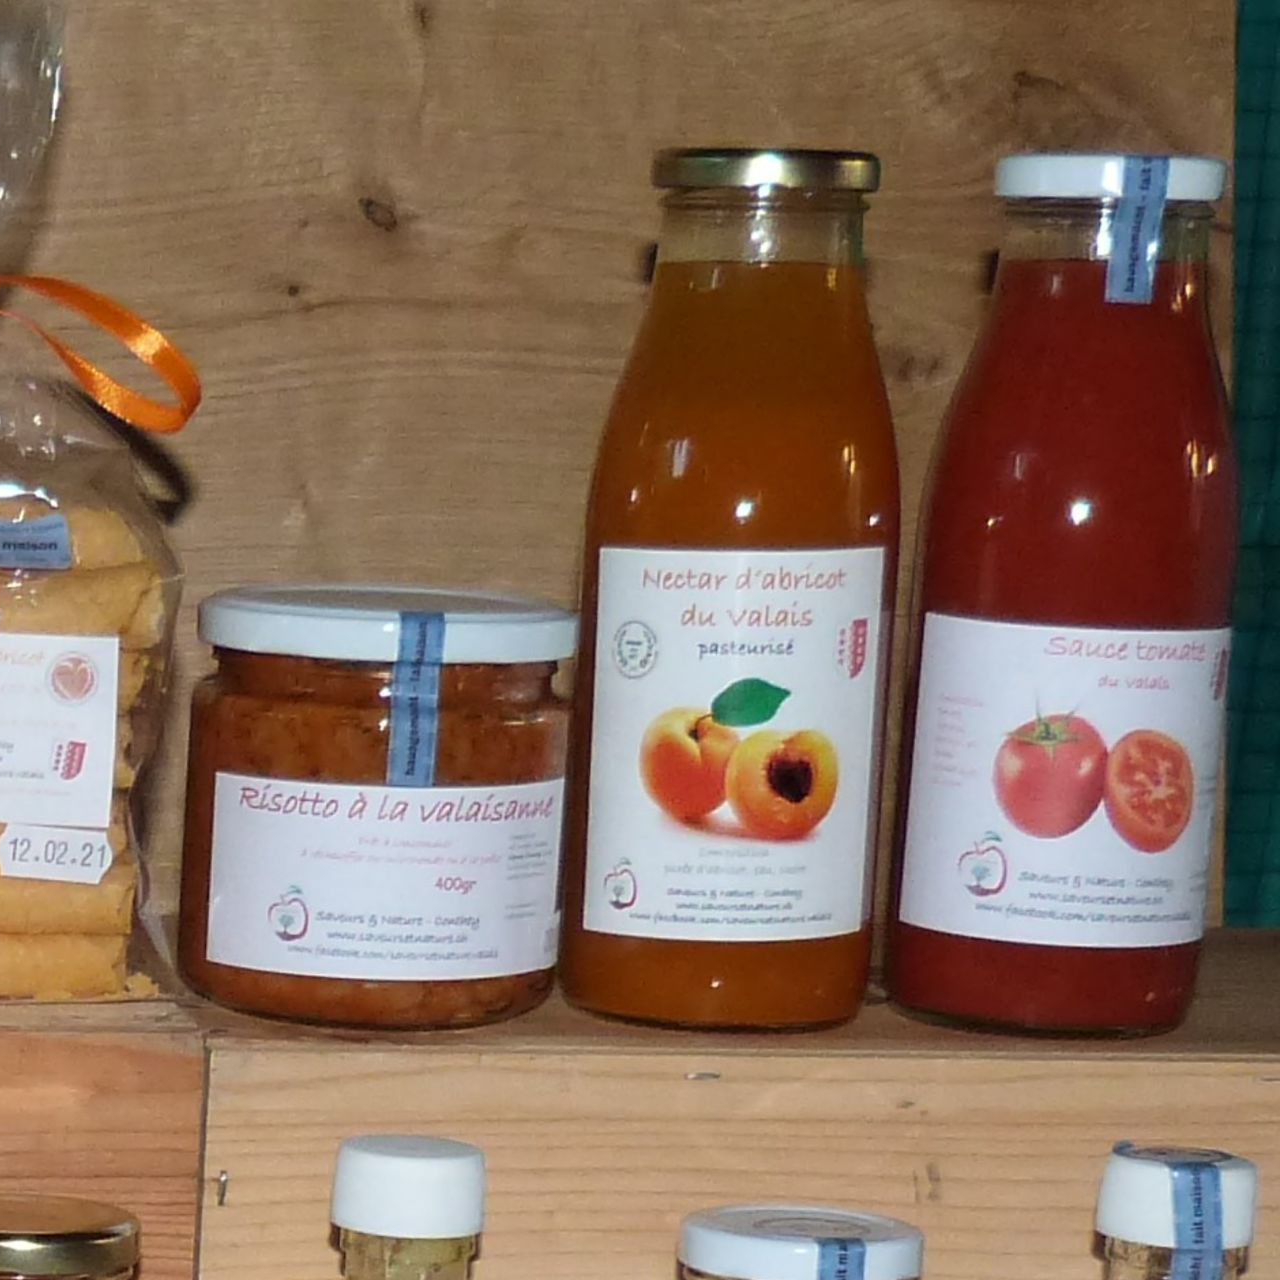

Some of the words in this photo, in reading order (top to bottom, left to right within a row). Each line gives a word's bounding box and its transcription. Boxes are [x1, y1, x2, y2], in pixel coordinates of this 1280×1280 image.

[2, 538, 59, 552] maison
[642, 567, 727, 590] Nectar
[735, 566, 847, 591] d'abricot
[681, 605, 716, 627] du
[698, 640, 794, 660] pasteurisé
[1044, 636, 1129, 661] Sauce
[1136, 640, 1206, 661] tomate
[240, 784, 339, 819] Risotto
[348, 793, 367, 819] à
[378, 797, 408, 820] la
[9, 836, 106, 869] 12.02.21
[435, 876, 477, 893] 400gr
[1192, 1220, 1206, 1244] fait
